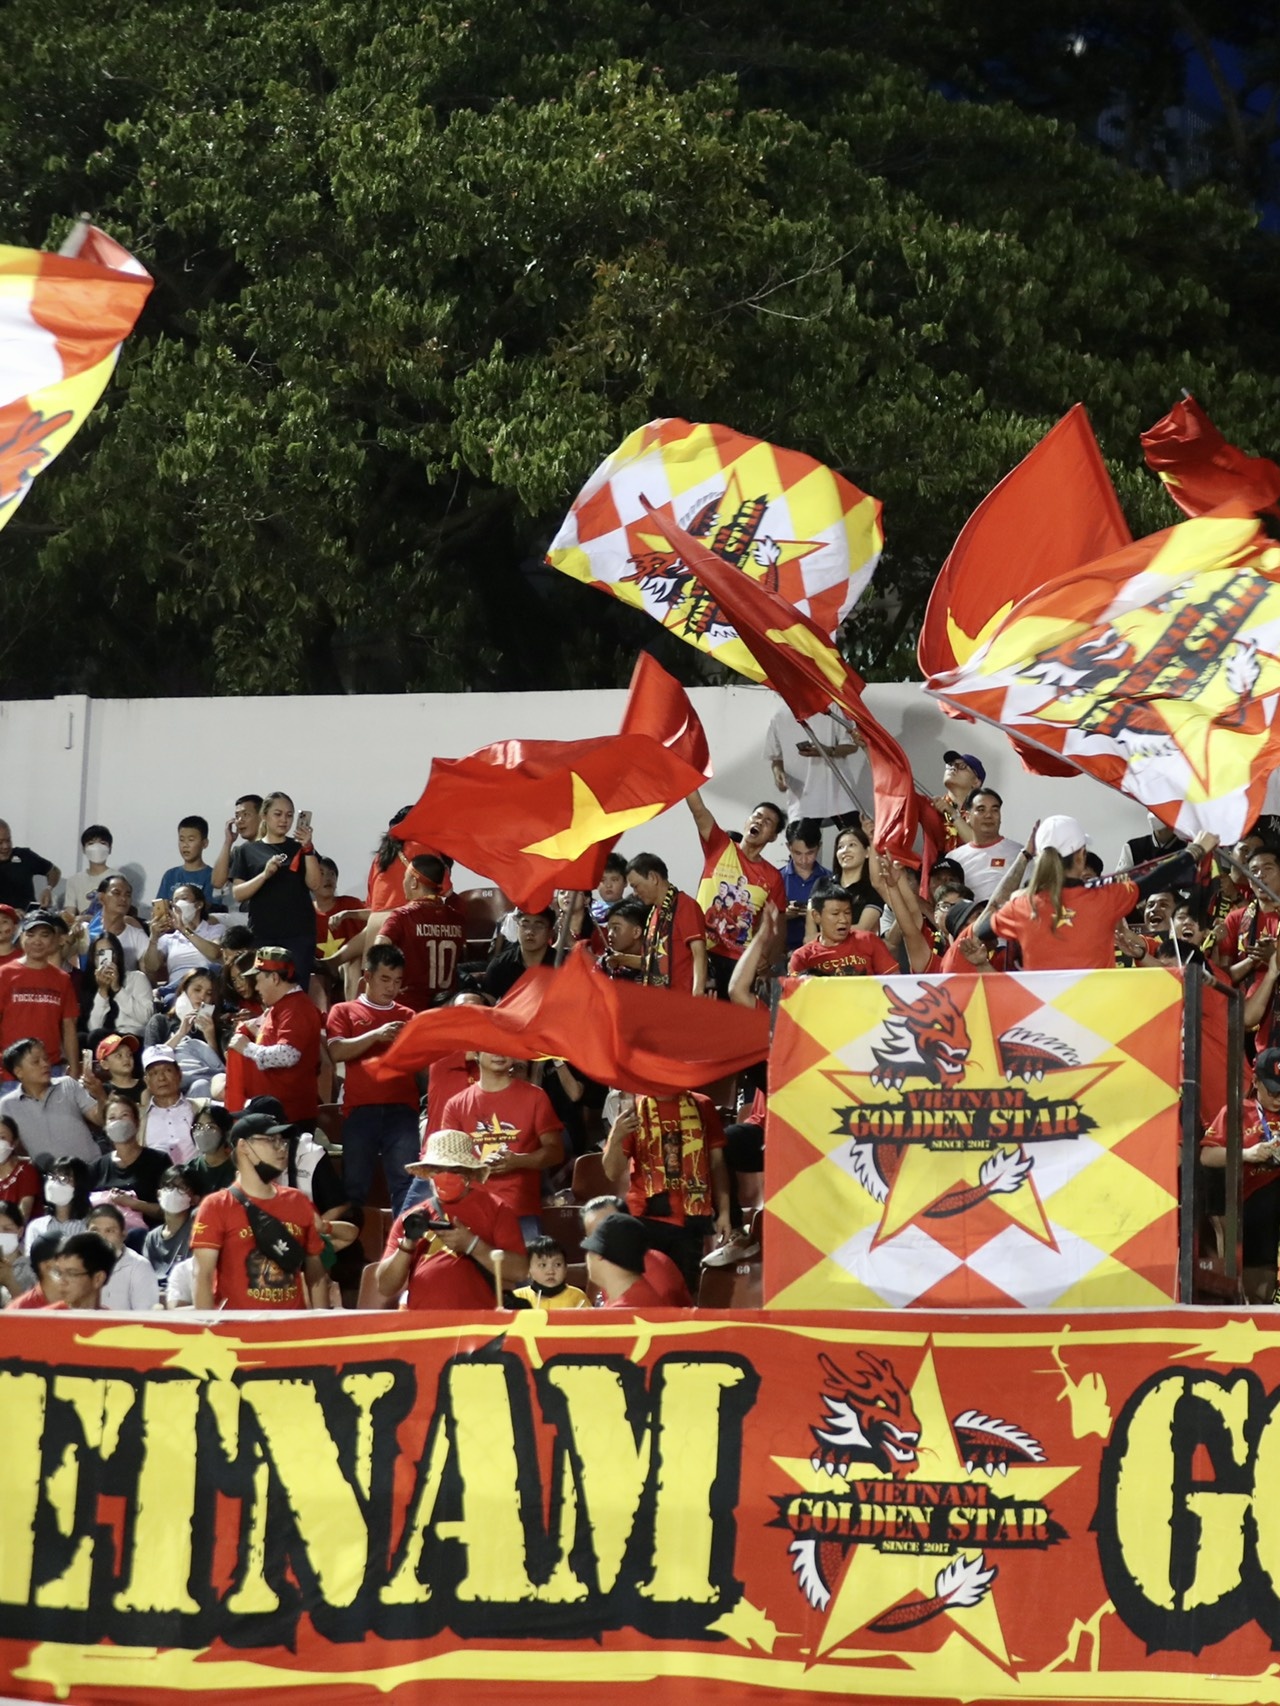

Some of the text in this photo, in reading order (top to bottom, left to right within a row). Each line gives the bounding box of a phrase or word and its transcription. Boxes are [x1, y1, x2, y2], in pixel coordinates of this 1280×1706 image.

[426, 939, 457, 989] 10
[905, 1088, 1025, 1109] VIETNAM
[848, 1104, 1081, 1139] GOLDEN STAR
[931, 1139, 991, 1150] SINCE 2017
[736, 1265, 751, 1275] 60
[853, 1481, 988, 1506] VIETNAM
[787, 1497, 1050, 1542] GOLDEN STAR
[882, 1540, 951, 1554] SINCE 2017
